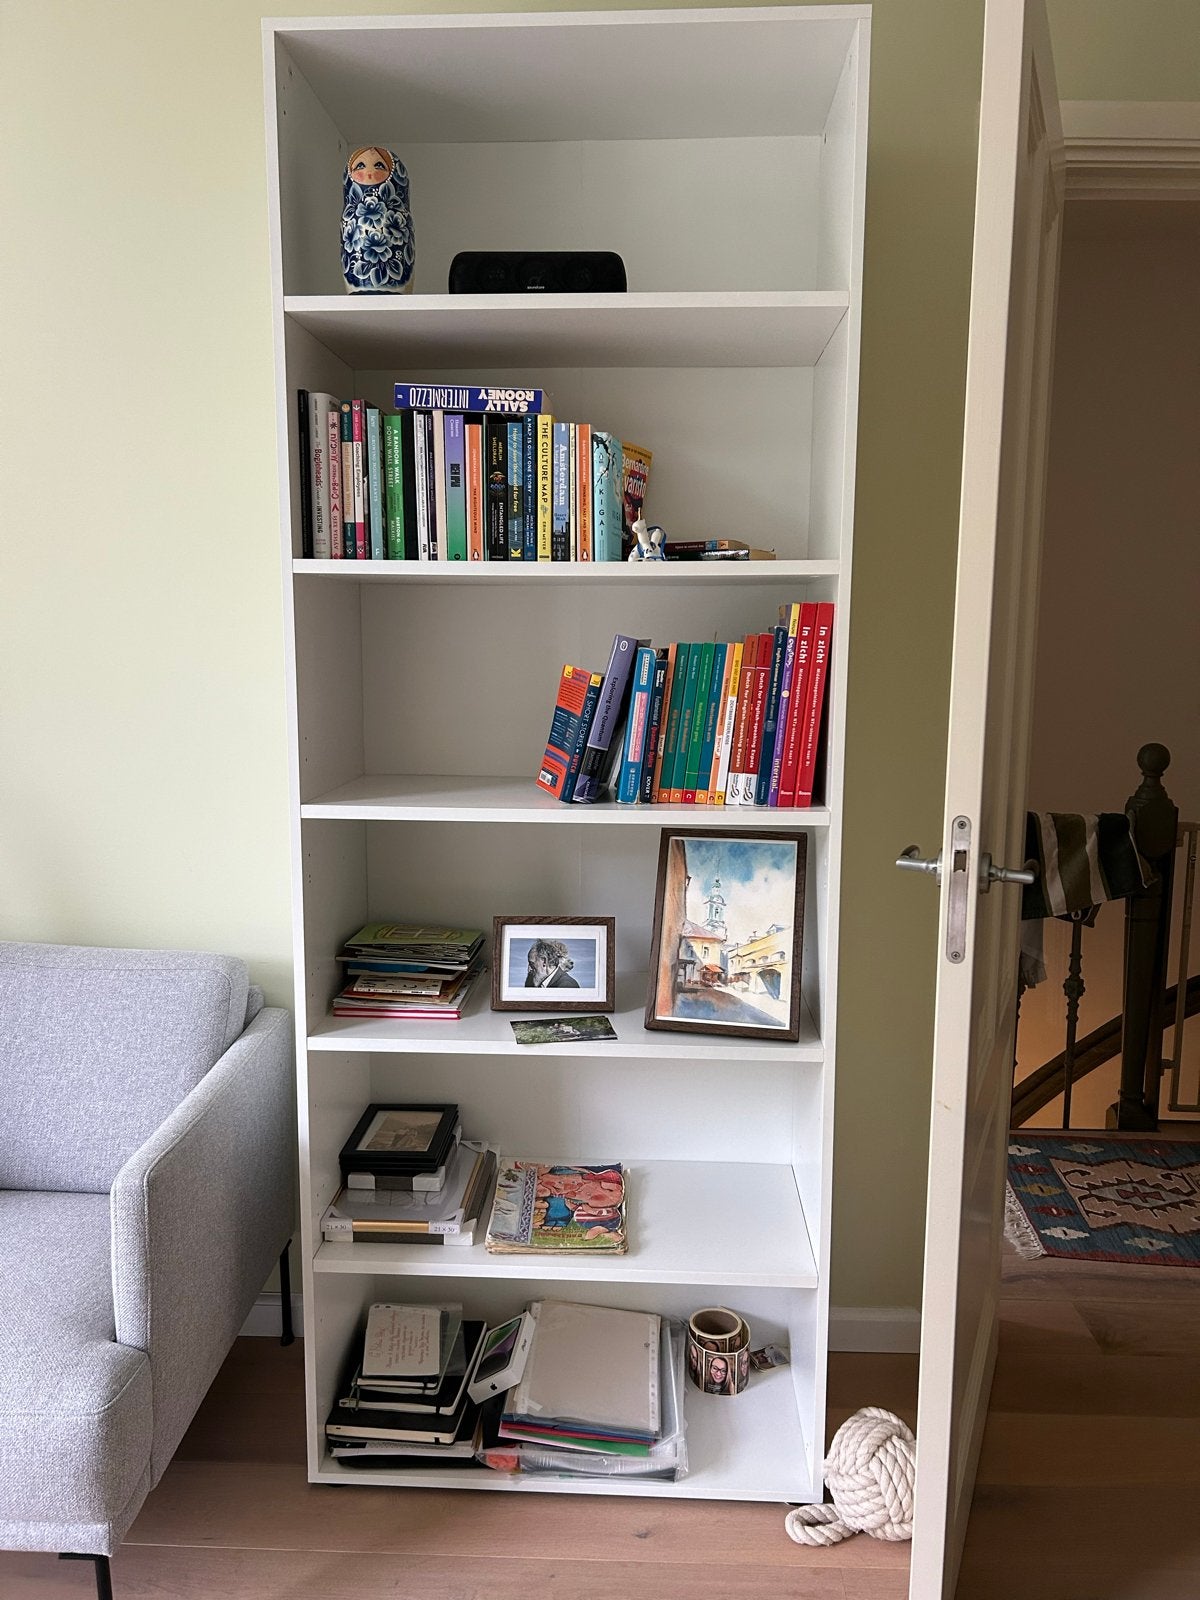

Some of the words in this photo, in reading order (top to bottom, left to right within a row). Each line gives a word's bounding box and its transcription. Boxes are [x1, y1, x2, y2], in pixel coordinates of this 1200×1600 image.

[409, 387, 469, 409] INTERMEZZO
[478, 389, 535, 402] ROONEY
[484, 400, 528, 412] SALLY
[559, 444, 568, 506] Amsterdam
[802, 627, 811, 636] In
[819, 626, 828, 636] In
[799, 640, 809, 664] zicht
[816, 640, 826, 664] zicht
[605, 677, 619, 704] Exploring
[583, 700, 593, 721] SHORT
[603, 705, 612, 714] the
[653, 696, 662, 721] Fundamentals
[576, 723, 588, 748] STORIES
[596, 715, 608, 742] Quantum
[737, 700, 748, 748] English-speaking
[750, 700, 762, 748] English-speaking
[569, 754, 580, 773] DUTCH
[647, 751, 655, 768] Optics
